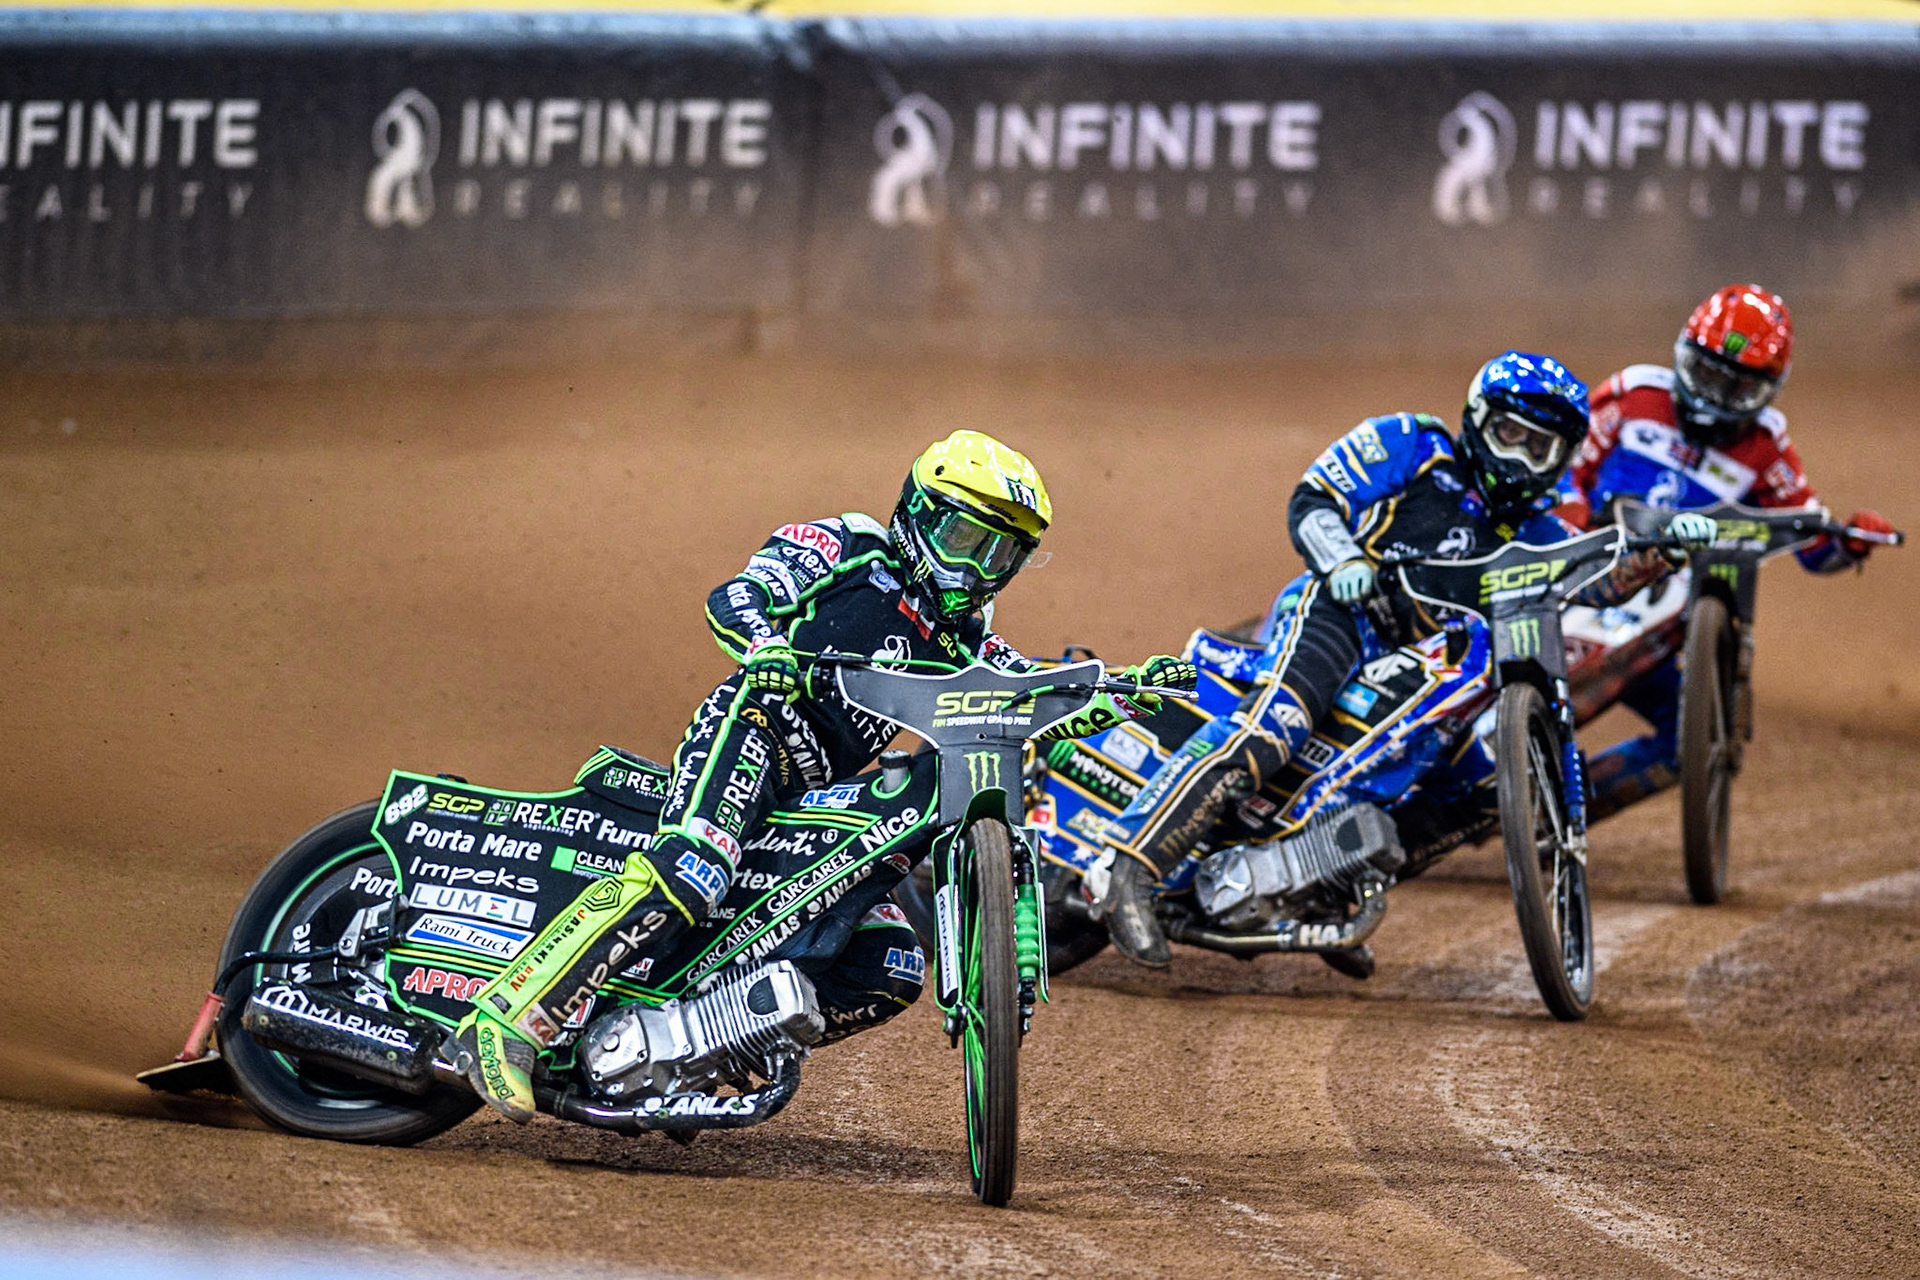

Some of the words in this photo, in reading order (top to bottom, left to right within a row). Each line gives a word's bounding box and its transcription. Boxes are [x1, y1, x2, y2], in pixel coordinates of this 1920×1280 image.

[0, 101, 260, 168] FINITE
[459, 99, 771, 167] INFINITE
[973, 102, 1321, 171] INFINITE
[1534, 100, 1871, 170] INFINITE
[781, 524, 841, 562] APRO
[1480, 561, 1550, 596] SGP
[946, 715, 987, 727] SPEEDWAY
[1013, 716, 1032, 726] PRIX
[722, 732, 770, 811] REXER
[384, 783, 430, 825] 692
[428, 792, 486, 814] SGP
[512, 801, 596, 833] REXER
[596, 818, 660, 850] Furn
[859, 807, 920, 853] Nice
[405, 820, 476, 853] Porta
[480, 833, 543, 861] Mare
[576, 851, 626, 874] CLEAN
[350, 867, 398, 899] Port
[409, 856, 540, 894] Impeks
[766, 848, 854, 914] GARCAREK
[823, 864, 873, 910] ANLAS
[412, 886, 529, 924] LUMEL
[709, 907, 737, 920] ANS
[290, 922, 313, 984] Mre
[419, 917, 462, 938] Rami
[465, 928, 515, 955] Truck
[533, 908, 588, 966] JASINSKI
[686, 911, 763, 982] GARCAREK
[751, 914, 801, 960] ANLAS
[403, 966, 490, 1002] APRO
[307, 1003, 409, 1044] MARWIS
[480, 1027, 516, 1101] daytona
[669, 1094, 761, 1116] ANLAS
